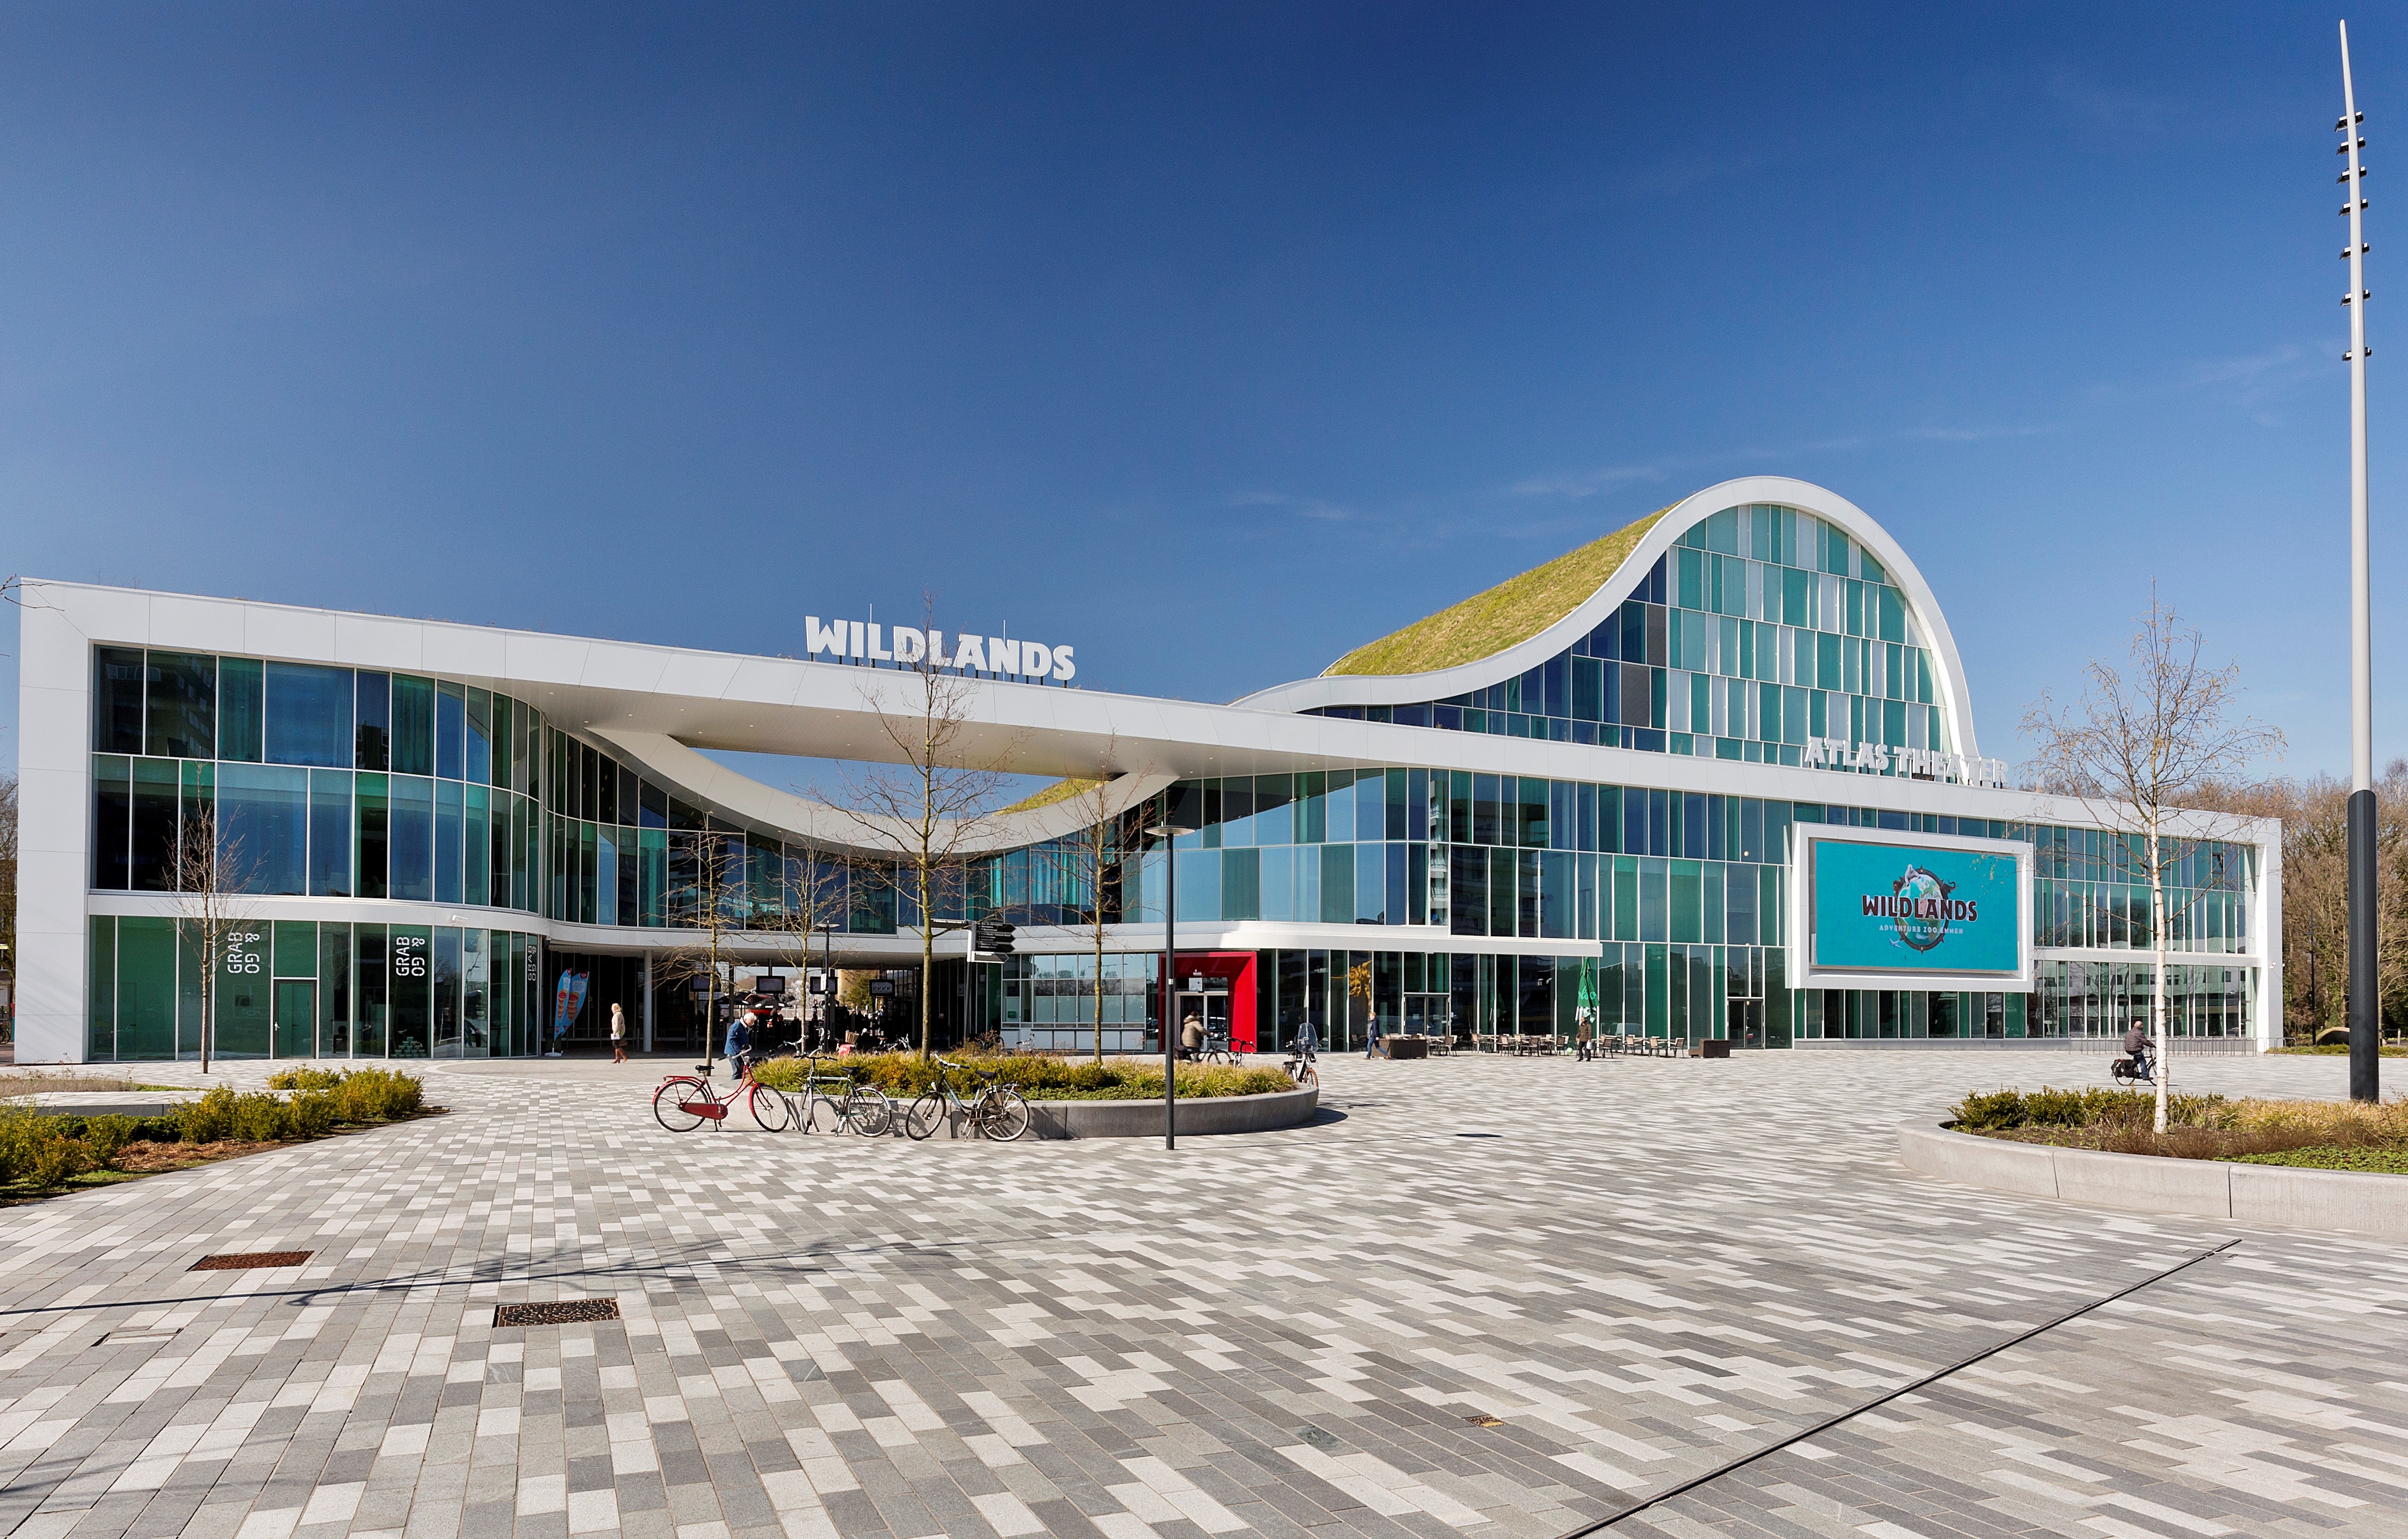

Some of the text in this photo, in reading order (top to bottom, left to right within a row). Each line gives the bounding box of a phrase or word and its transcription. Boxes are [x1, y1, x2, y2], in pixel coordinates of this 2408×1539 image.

[805, 615, 1076, 681] WILDLANDS
[1805, 735, 2009, 783] ATLAS THEATER
[1862, 894, 1978, 922] WILDLANDS
[1879, 924, 1921, 933] ADVENTURE
[227, 932, 243, 973] GRAB
[244, 932, 260, 974] & GO
[396, 937, 410, 976] GRAB
[411, 937, 425, 976] & GO
